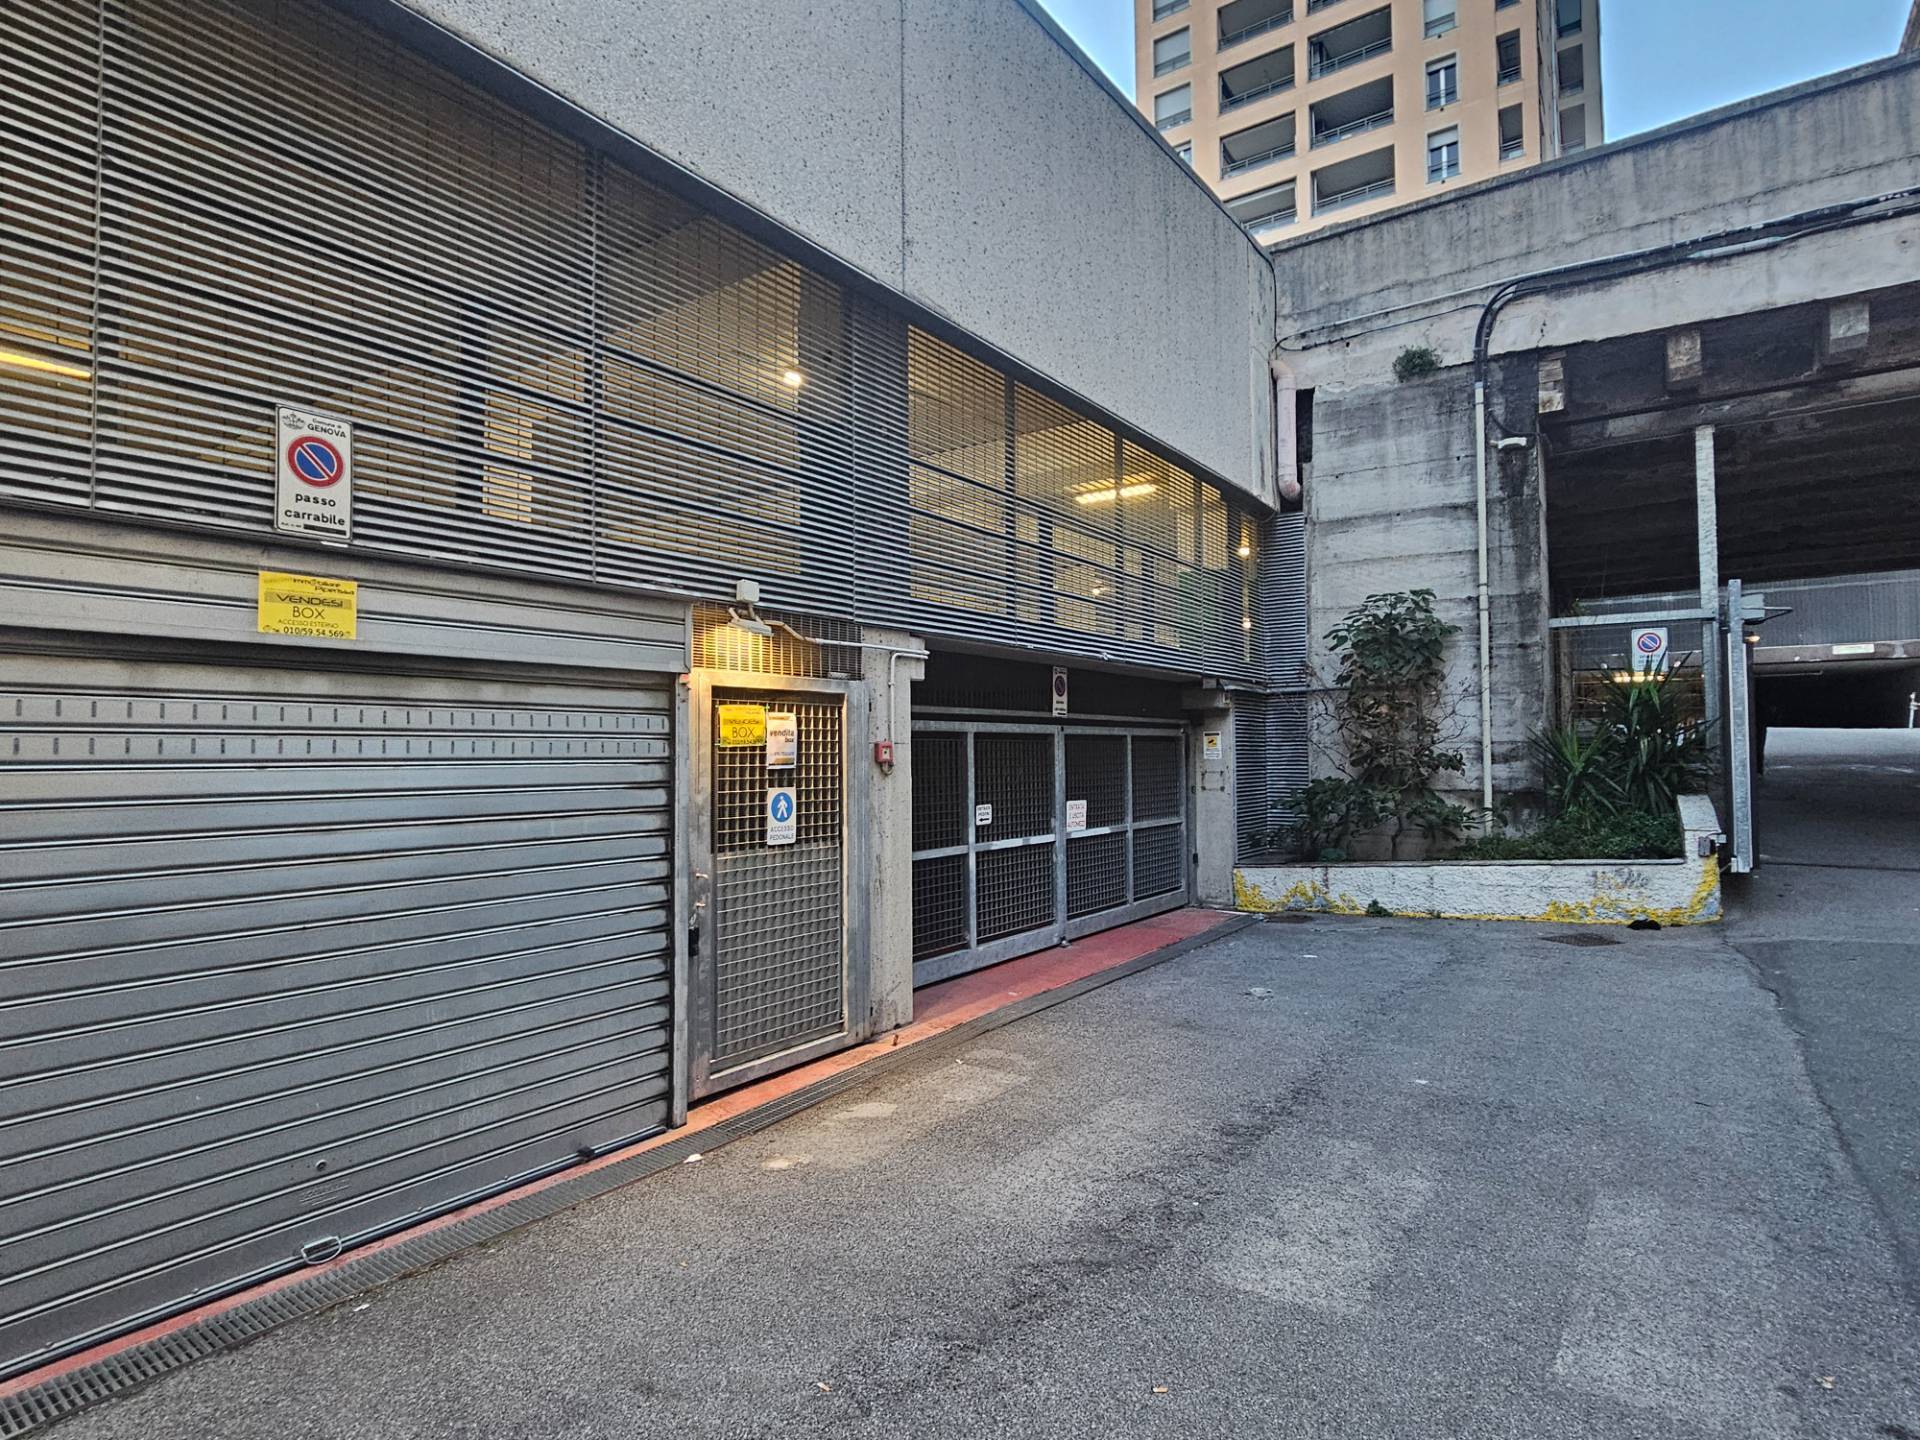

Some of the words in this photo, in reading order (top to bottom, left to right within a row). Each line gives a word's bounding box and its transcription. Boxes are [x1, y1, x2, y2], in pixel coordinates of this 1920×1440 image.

[307, 423, 346, 438] GENOVA
[295, 493, 336, 507] passo
[284, 509, 345, 525] carrabile
[277, 593, 343, 608] VENDESI
[292, 606, 326, 620] BOX
[310, 621, 339, 629] ESTERNO
[732, 727, 756, 739] BOX
[770, 729, 795, 737] vendita
[770, 824, 794, 833] ACCESSO
[770, 832, 794, 841] PEDONALE
